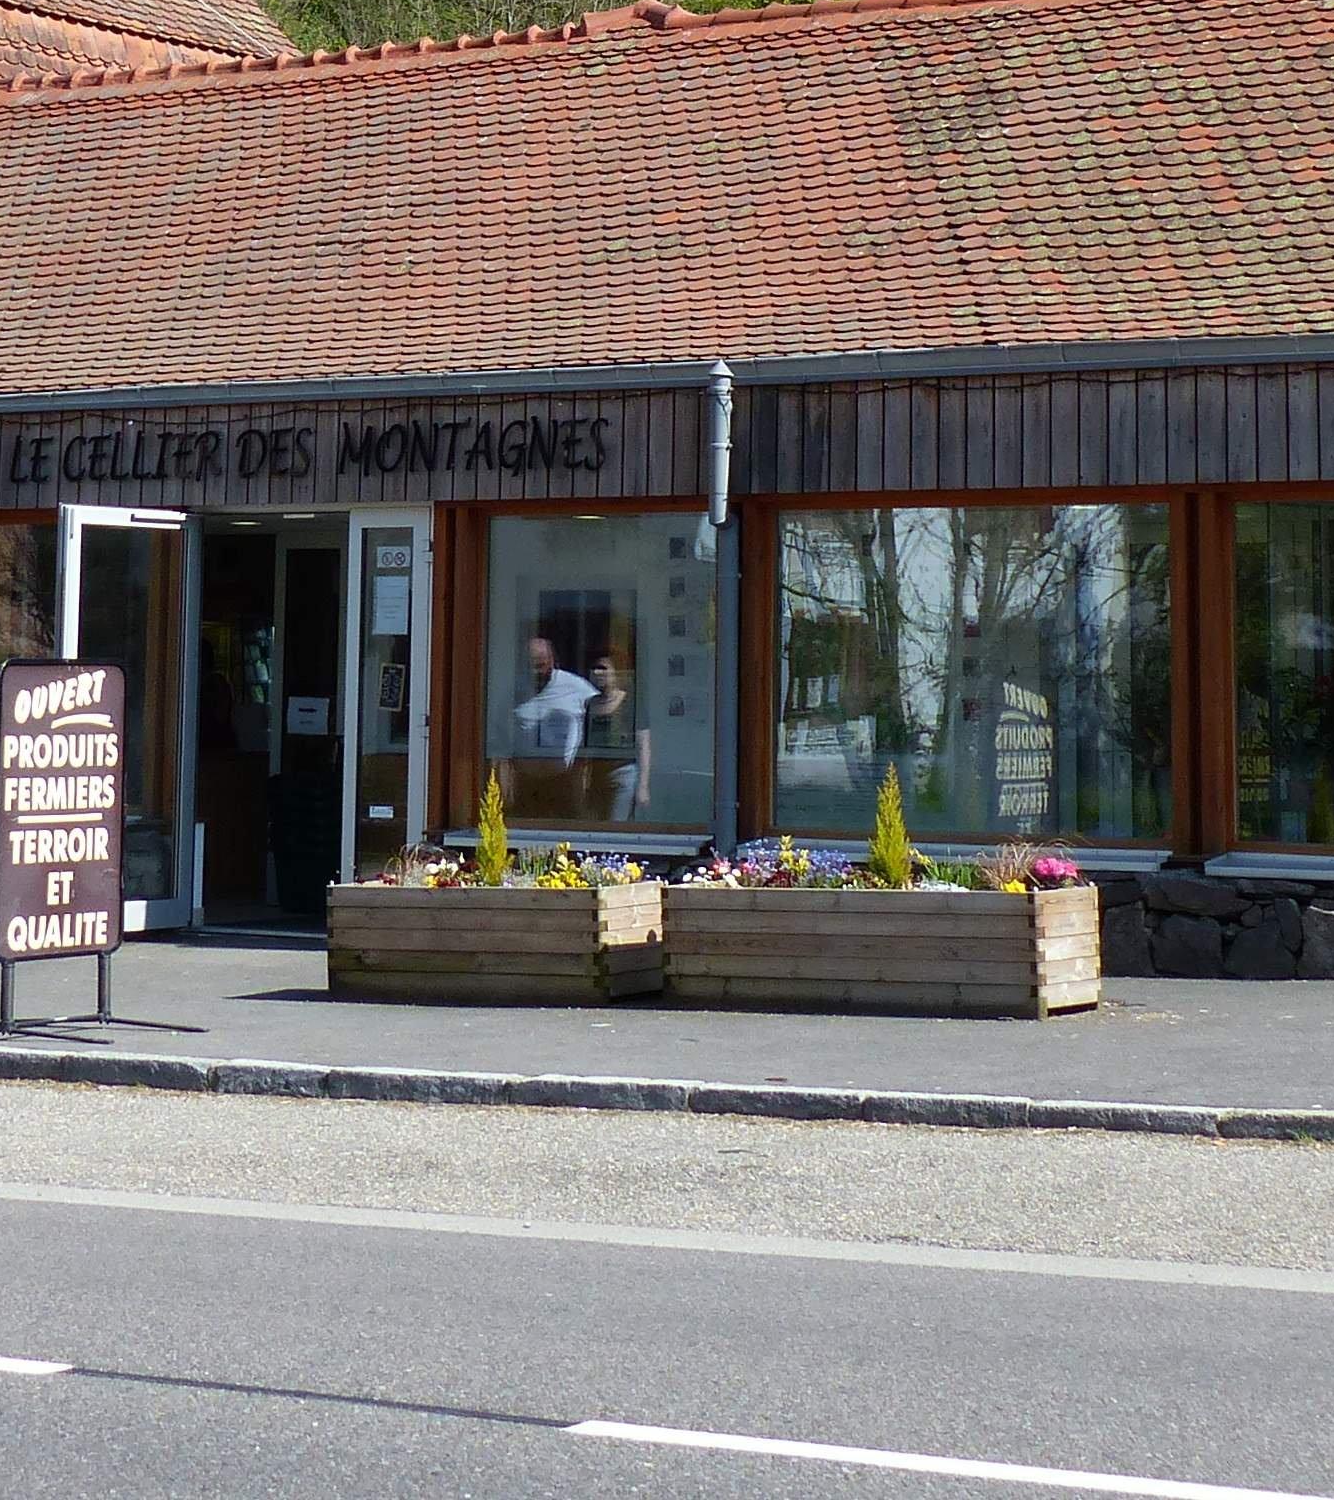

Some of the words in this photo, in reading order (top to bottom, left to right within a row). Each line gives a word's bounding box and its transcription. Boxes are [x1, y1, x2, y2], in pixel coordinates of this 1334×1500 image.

[10, 435, 53, 483] LE
[63, 430, 223, 483] CELLIER
[235, 426, 314, 479] DES
[338, 415, 612, 477] MONTAGNES
[14, 670, 106, 724] OUVERT
[3, 733, 118, 769] PRODUITS
[3, 775, 115, 811] FERMIERS
[9, 828, 109, 865] TERROIR
[47, 871, 74, 906] ET
[7, 911, 108, 952] QUALITE
